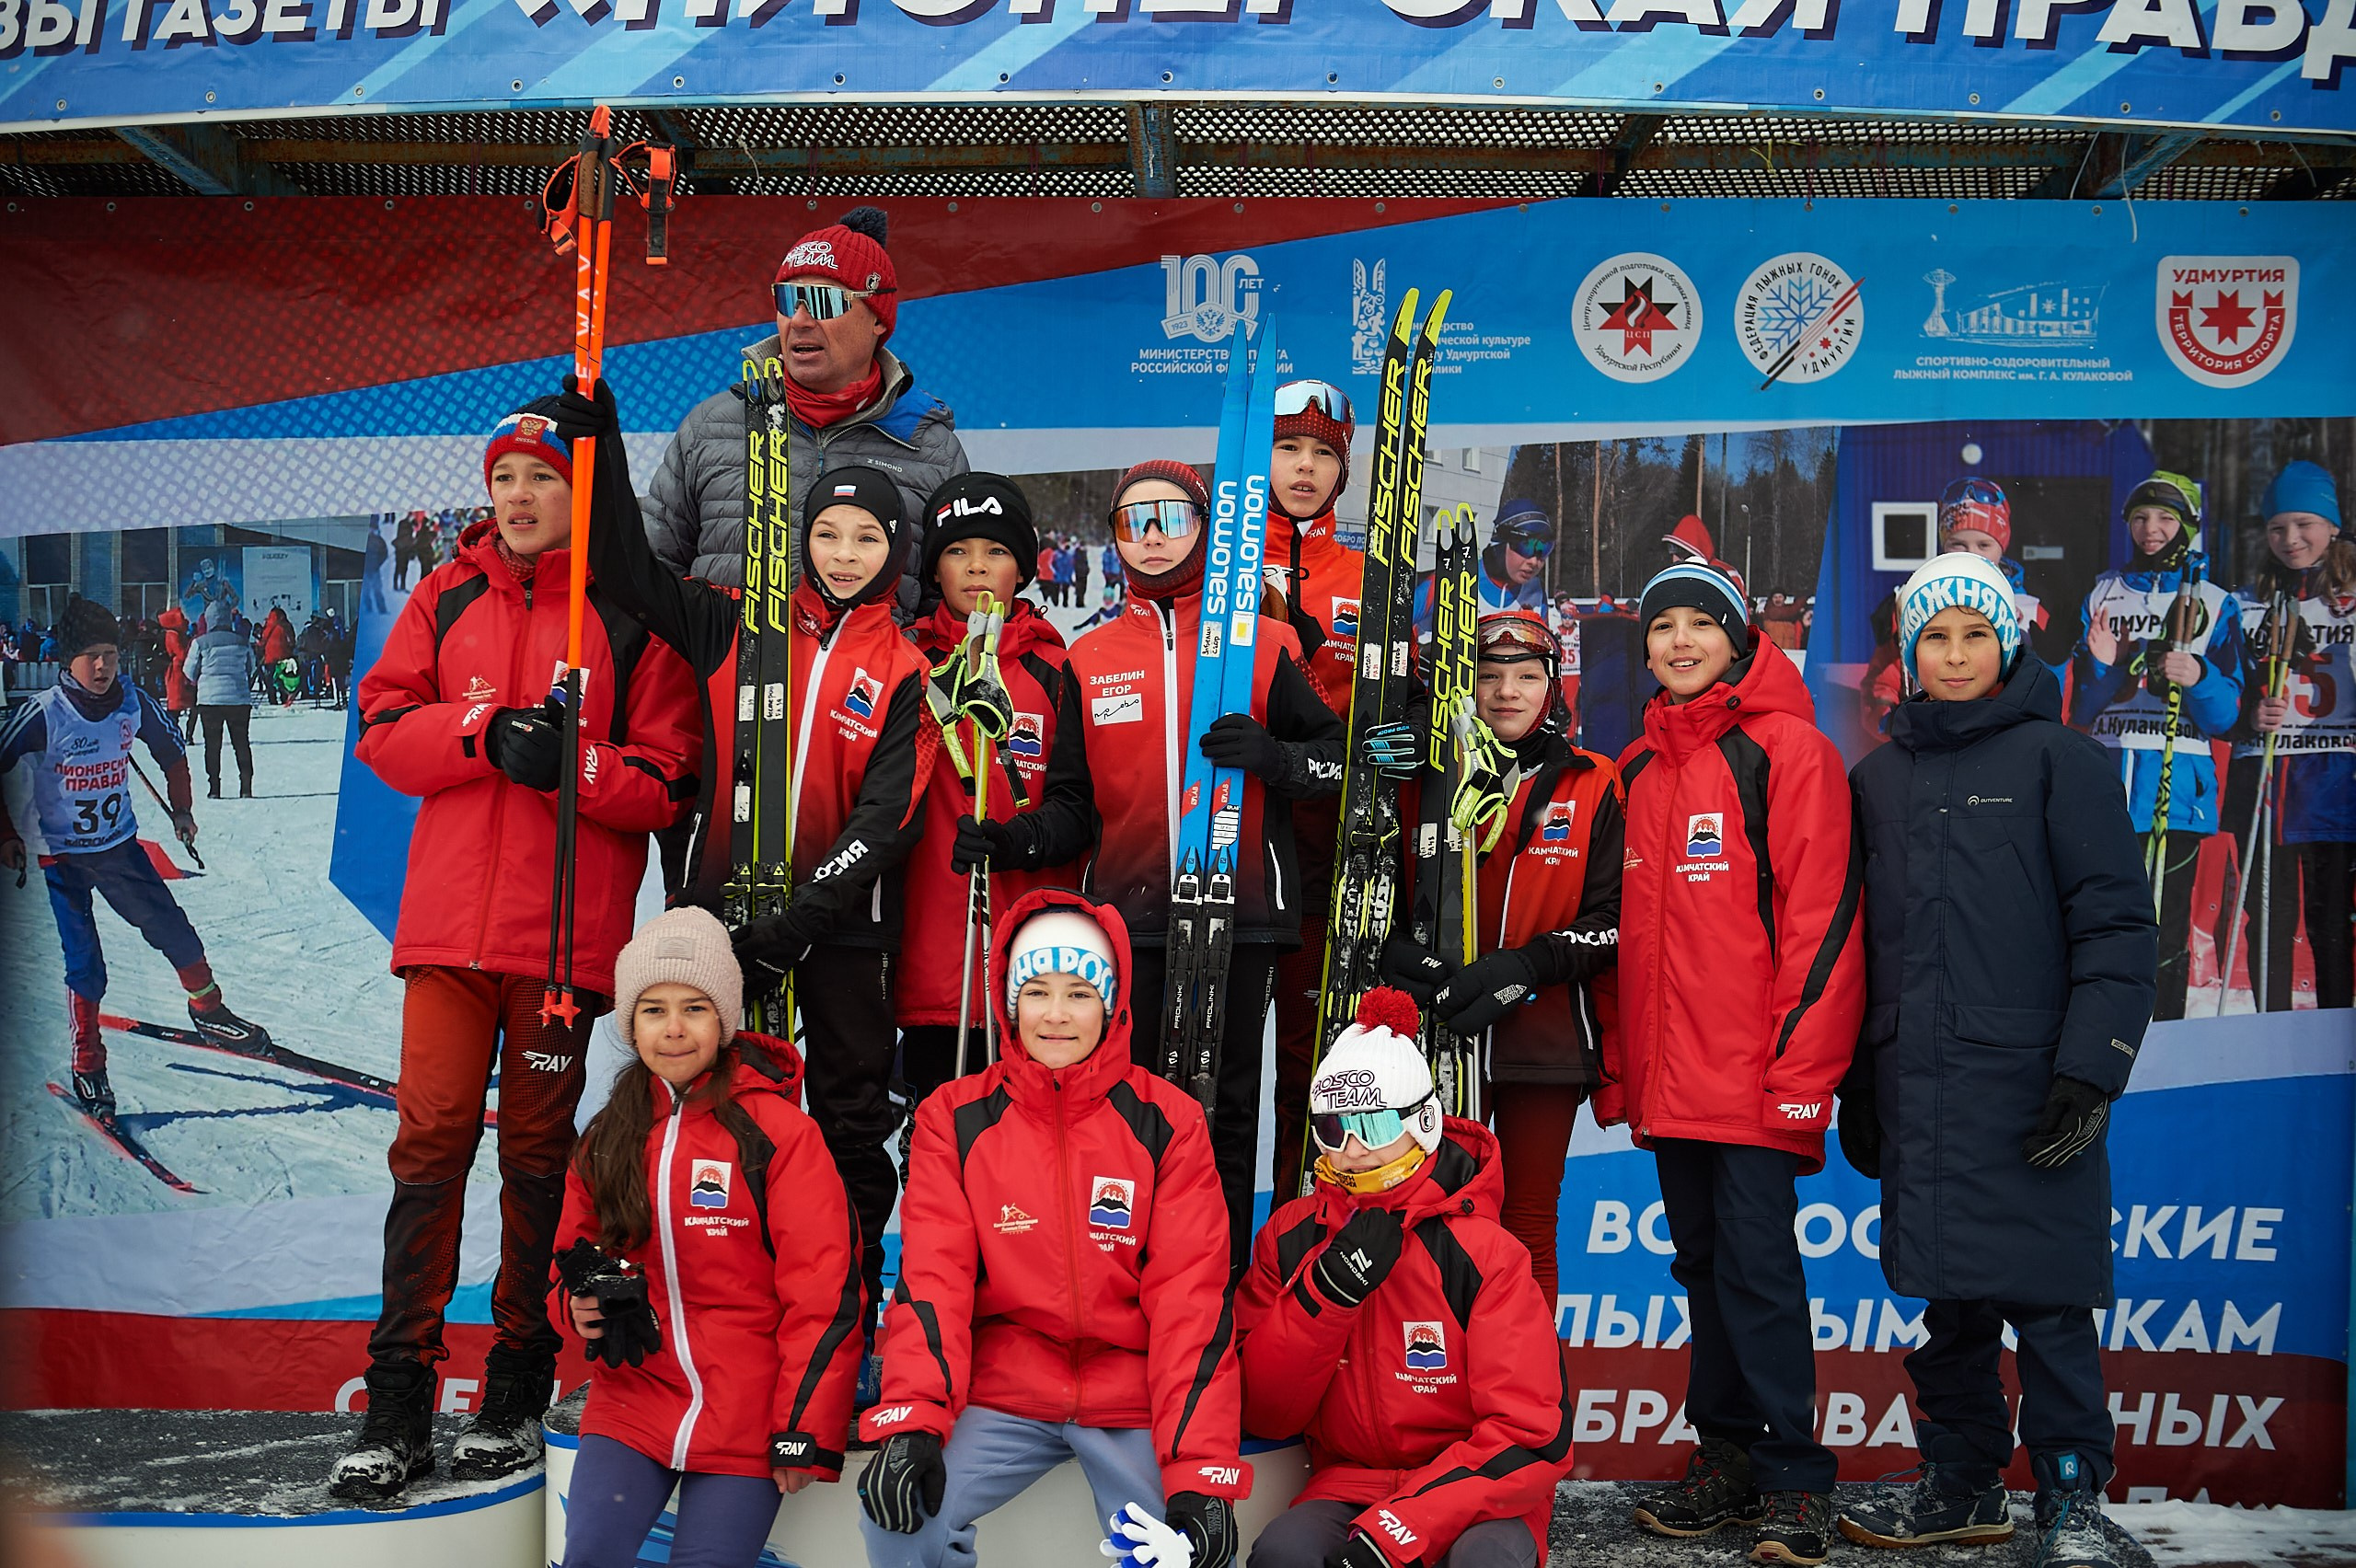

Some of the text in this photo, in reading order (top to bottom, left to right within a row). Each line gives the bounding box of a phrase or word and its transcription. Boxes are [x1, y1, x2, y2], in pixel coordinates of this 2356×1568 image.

[1239, 278, 1265, 289] ЛЕТ
[2172, 269, 2285, 284] УДМУРТИЯ
[1744, 262, 1842, 360] ФЕДЕРАЦИЯ ЛЫЖНЫХ ГОНОК
[1482, 335, 1531, 347] культуре
[1801, 318, 1855, 374] УДМУРТИИ
[2173, 314, 2281, 370] ТЕРРИТОРИЯ СПОРТА
[1139, 349, 1230, 360] МИНИСТЕРСТВ
[1446, 348, 1510, 362] Удмуртской
[1131, 360, 1212, 374] РОССИЙСКОЙ
[1893, 368, 1950, 379] ЛЫЖНЫЙ
[1953, 370, 2015, 380] КОМПЛЕКС
[2062, 369, 2133, 382] КУЛАКОВОЙ
[874, 459, 903, 474] SIMOND
[1373, 357, 1404, 567] FISCHER
[1400, 357, 1433, 568] FISCHER
[936, 496, 1003, 528] FILA
[745, 430, 766, 635] FISCHER
[768, 430, 788, 635] FISCHER
[1235, 474, 1266, 612] salomon
[1207, 480, 1238, 615] salomon
[1089, 670, 1145, 686] ЗАБЕЛИН
[1429, 576, 1455, 774] FISCHER
[1102, 684, 1132, 697] ЕГОР
[73, 793, 121, 836] 39
[1688, 872, 1711, 882] КРАЙ
[1421, 955, 1442, 971] FW
[1436, 986, 1450, 1003] FW
[522, 1050, 573, 1072] RAY
[1322, 1088, 1387, 1110] TEAM
[1777, 1102, 1821, 1120] RAY
[1339, 1251, 1369, 1286] NORDSKI
[870, 1406, 912, 1427] RAY
[775, 1440, 807, 1456] RAY
[1198, 1467, 1240, 1485] RAY
[1378, 1509, 1418, 1546] RAY
